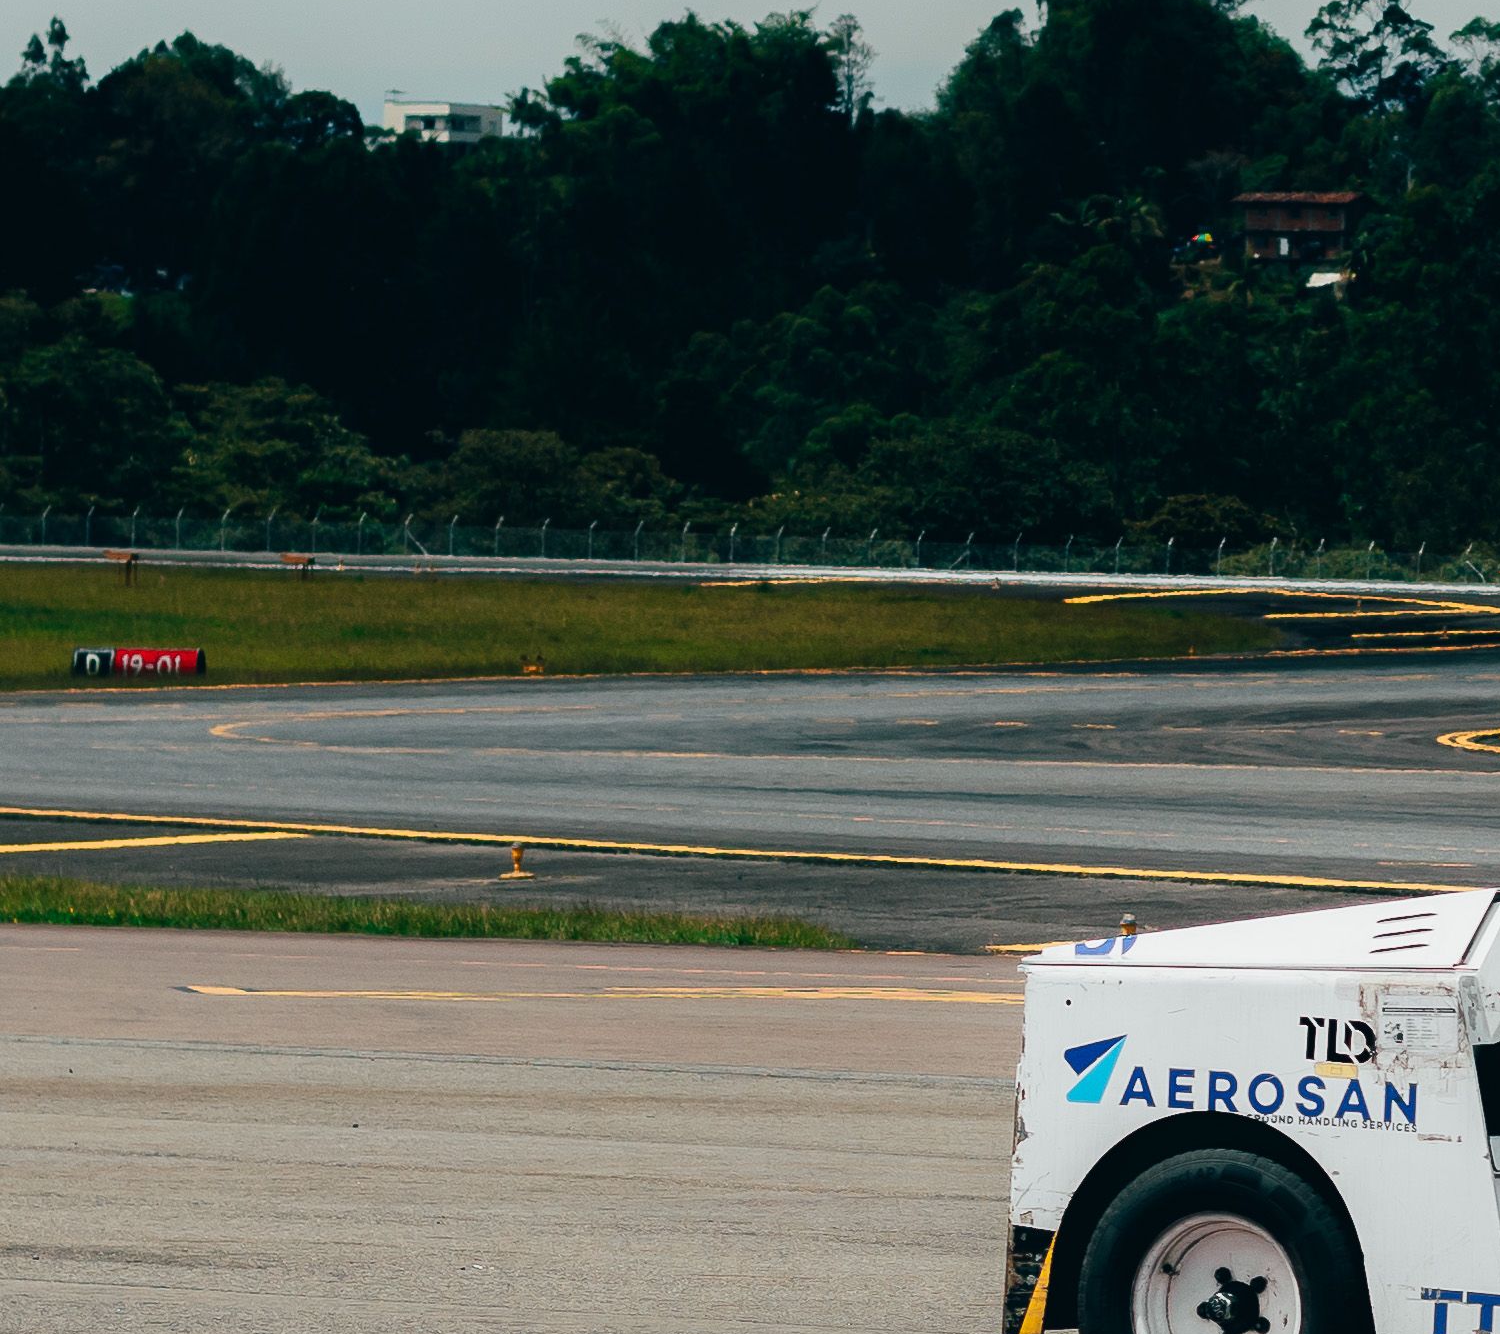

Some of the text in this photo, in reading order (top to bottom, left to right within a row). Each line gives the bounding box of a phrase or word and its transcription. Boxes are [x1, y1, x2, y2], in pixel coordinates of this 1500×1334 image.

[1299, 1016, 1377, 1064] TLD
[1119, 1066, 1418, 1127] AEROSAN
[1298, 1117, 1358, 1129] HANDLING
[1362, 1120, 1417, 1133] SERVICES
